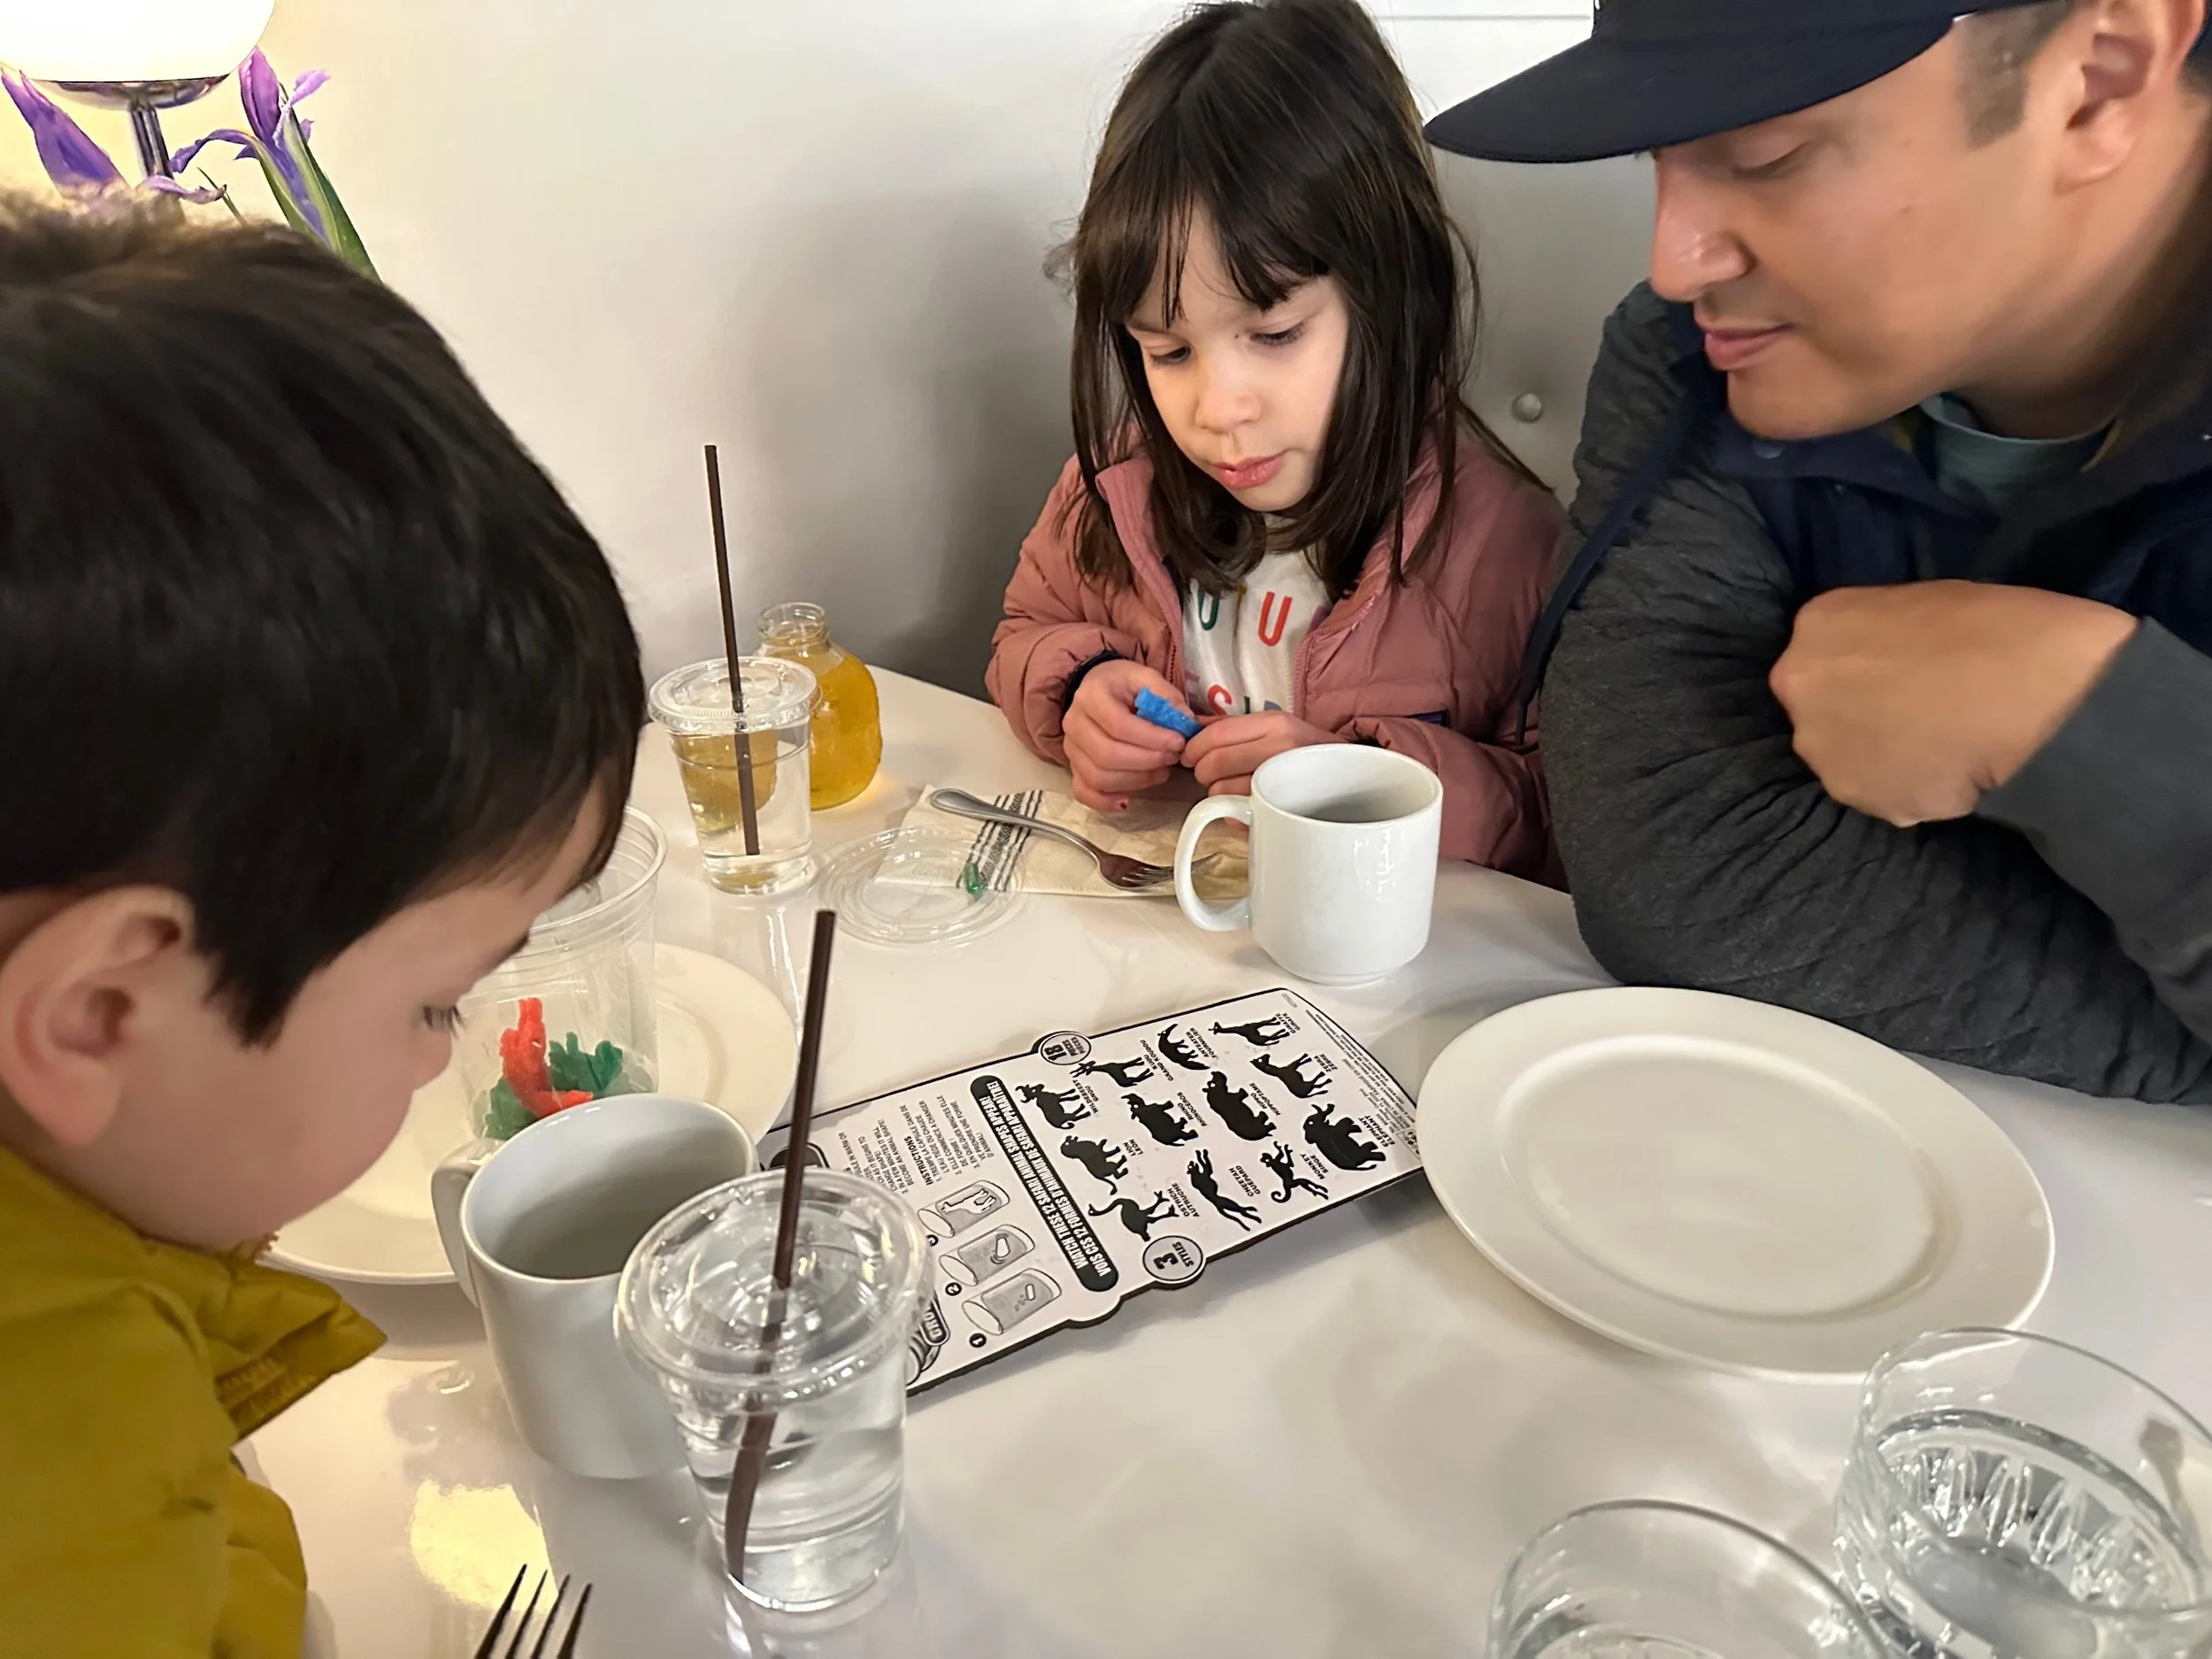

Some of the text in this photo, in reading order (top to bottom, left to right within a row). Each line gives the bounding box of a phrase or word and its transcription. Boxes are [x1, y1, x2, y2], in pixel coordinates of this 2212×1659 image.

[1275, 1012, 1296, 1033] GIRAFFE
[1043, 1044, 1067, 1061] 18
[1186, 1031, 1210, 1057] ANTEATER
[1140, 1040, 1174, 1081] GRAND KOUDOU
[1143, 1054, 1157, 1070] KUDU
[1313, 1055, 1332, 1072] ZEBRA
[1071, 1079, 1099, 1114] WILDEBEEST
[1084, 1086, 1099, 1102] GNOU
[1250, 1092, 1267, 1110] HIPPO
[1177, 1102, 1194, 1120] RHINO
[1010, 1123, 1034, 1150] SAFARI
[1357, 1118, 1389, 1148] ELEPHANT
[903, 1135, 933, 1186] INSTRUCTIONS
[1025, 1148, 1041, 1160] DE
[1123, 1141, 1136, 1156] LION
[1300, 1154, 1325, 1179] MONKEY
[1310, 1155, 1328, 1173] SINGE
[979, 1095, 1089, 1269] WATCH THESE 12 SAFARI ANIMAL SHAPES APPEAR!
[1031, 1156, 1064, 1198] D'ANIMAUX
[1228, 1167, 1254, 1197] CHEETAH
[1055, 1195, 1083, 1229] FORMES
[1166, 1187, 1190, 1217] OSTRICH
[1171, 1182, 1200, 1217] AUTRUCHE
[1072, 1225, 1089, 1239] 12
[1079, 1236, 1099, 1255] CES
[1171, 1241, 1194, 1267] STYLES
[1089, 1252, 1111, 1277] VOIS
[1153, 1252, 1179, 1270] 3
